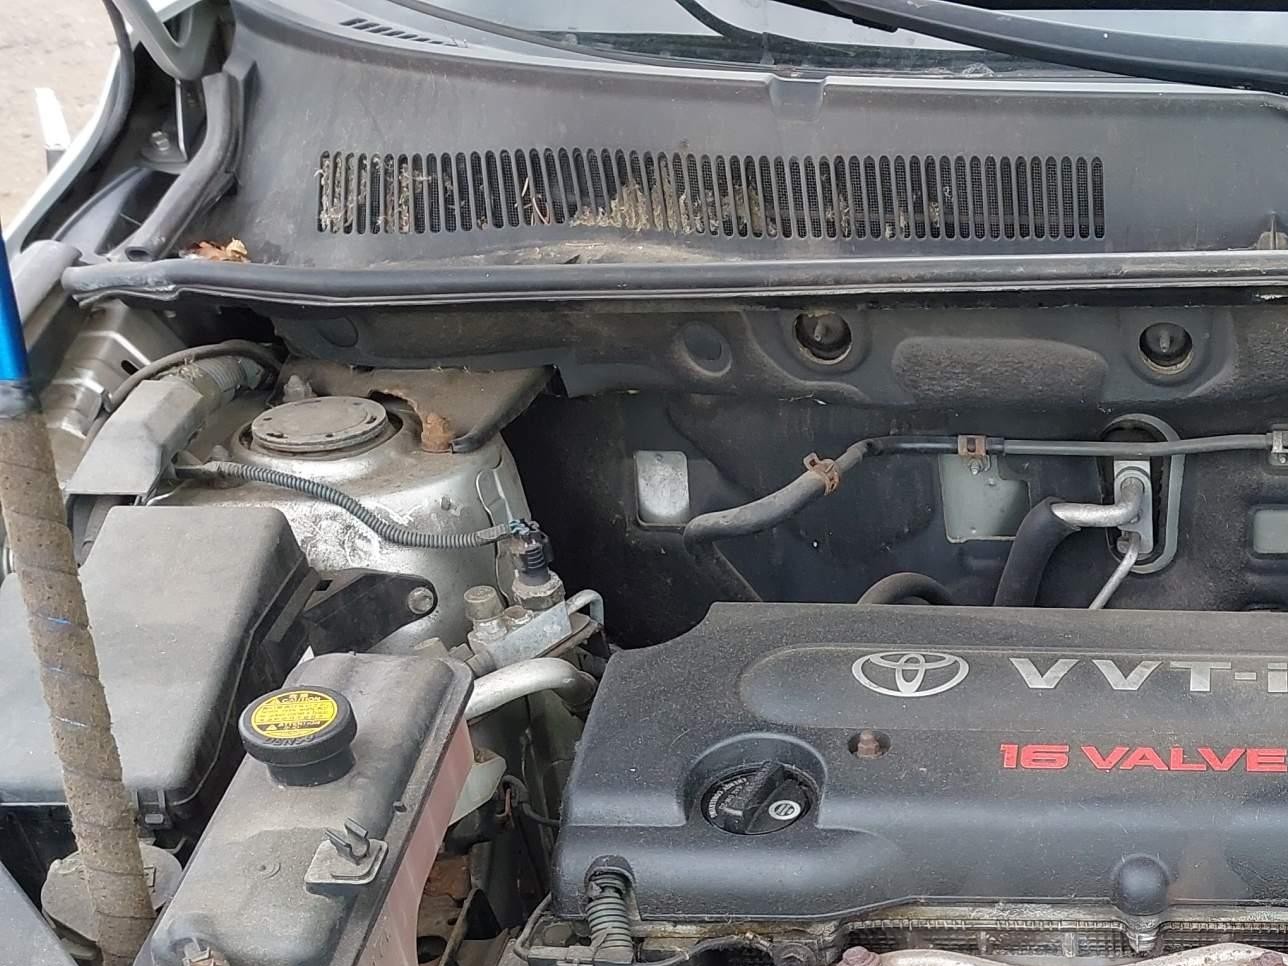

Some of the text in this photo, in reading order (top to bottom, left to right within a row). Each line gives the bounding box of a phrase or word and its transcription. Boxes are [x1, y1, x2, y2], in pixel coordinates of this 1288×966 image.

[1008, 657, 1288, 693] VVT-i
[1000, 743, 1288, 772] 16 VALVE
